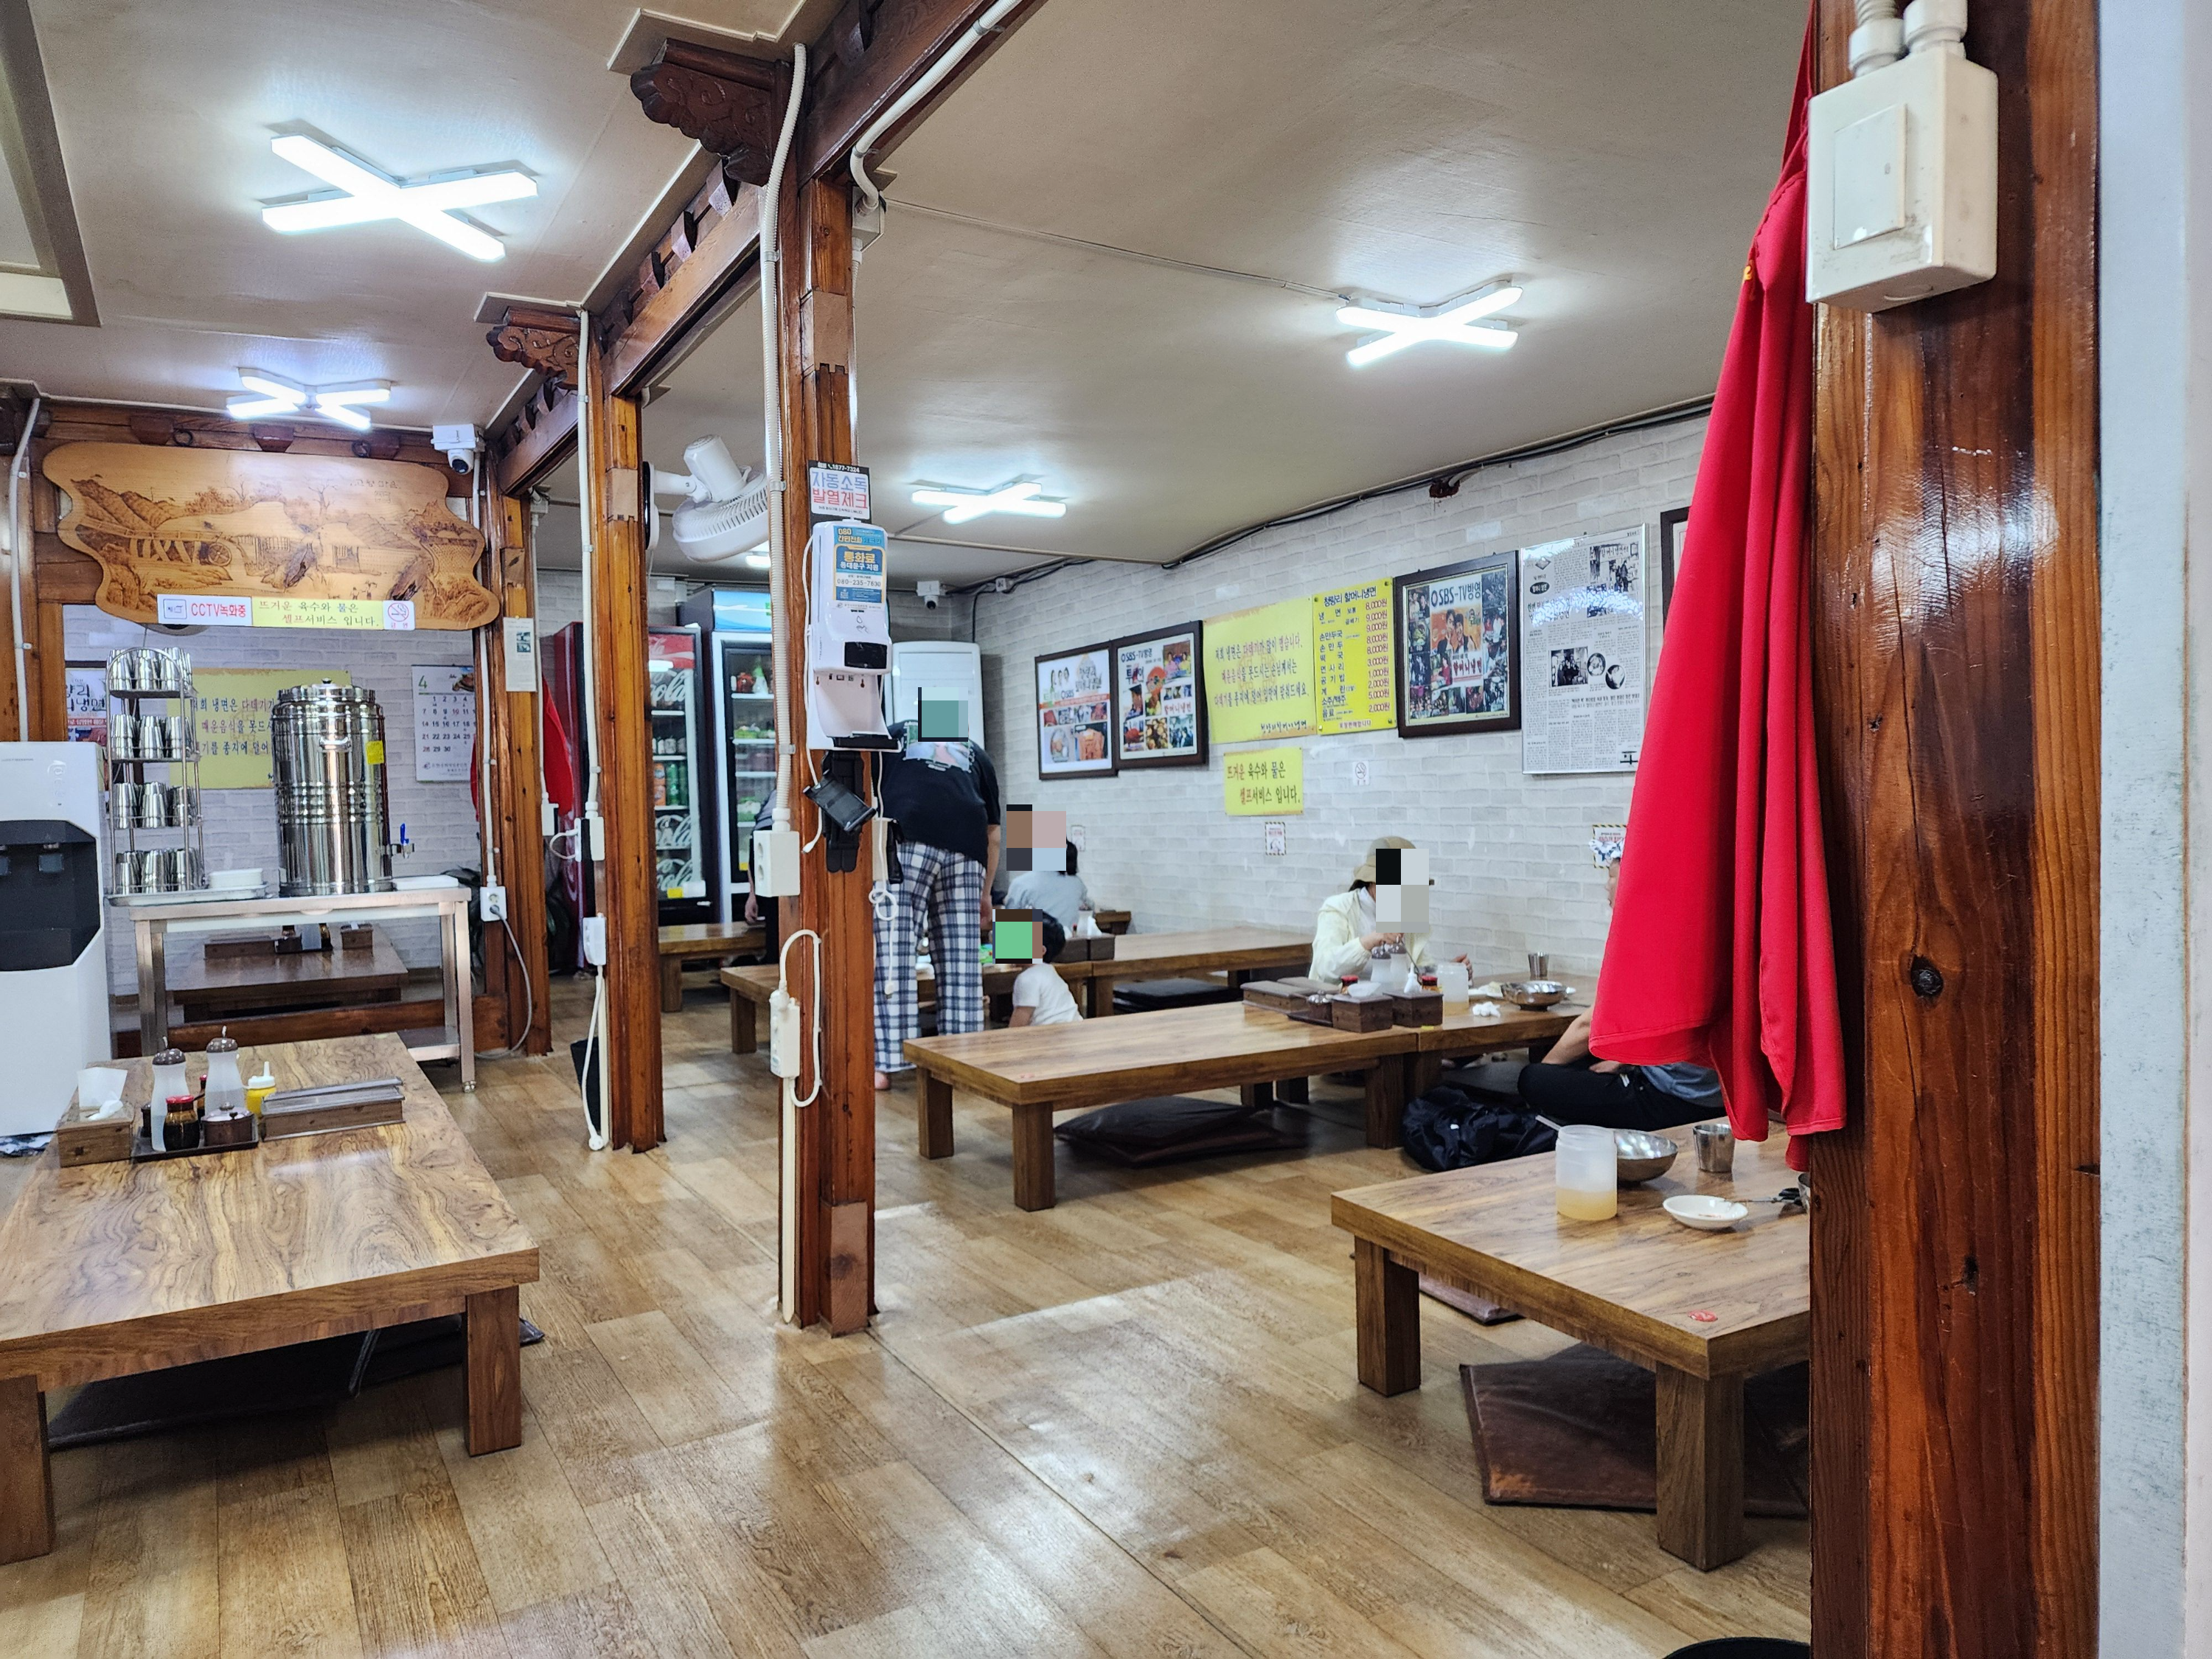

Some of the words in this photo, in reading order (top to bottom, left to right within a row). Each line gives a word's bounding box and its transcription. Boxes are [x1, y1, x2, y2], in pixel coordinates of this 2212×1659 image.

[832, 464, 860, 473] 1877-7324
[812, 471, 867, 493] 자동소독
[813, 487, 868, 509] 발열체크
[844, 551, 876, 564] 통화료
[1345, 585, 1377, 602] 할머니냉면
[191, 603, 246, 618] CCTV녹화중
[259, 600, 293, 611] 뜨거운
[300, 601, 332, 612] 육수와
[338, 602, 359, 613] 물은
[1366, 598, 1388, 611] 8,000원
[282, 614, 338, 625] 셀프서비스
[344, 616, 380, 627] 입니다.
[1366, 609, 1388, 622] 9,000원
[1319, 630, 1343, 641] 손만두국
[1366, 620, 1388, 633] 9,000원
[1367, 632, 1388, 644] 8,000원
[1367, 643, 1388, 655] 8,000원
[1367, 655, 1389, 667] 3,000원
[1368, 667, 1389, 678] 1,000원
[418, 675, 428, 689] 4
[1368, 678, 1390, 689] 2,000원
[1368, 689, 1390, 700] 5,000원
[212, 698, 238, 713] 냉면은
[1369, 702, 1391, 713] 2,000원
[196, 740, 218, 756] 기를
[223, 740, 248, 756] 종지에
[1227, 763, 1245, 780] 뜨거운
[1248, 761, 1268, 780] 육수와
[1271, 761, 1287, 779] 물은
[1240, 786, 1273, 805] 셀프서비스
[1276, 785, 1301, 805] 입니다.
